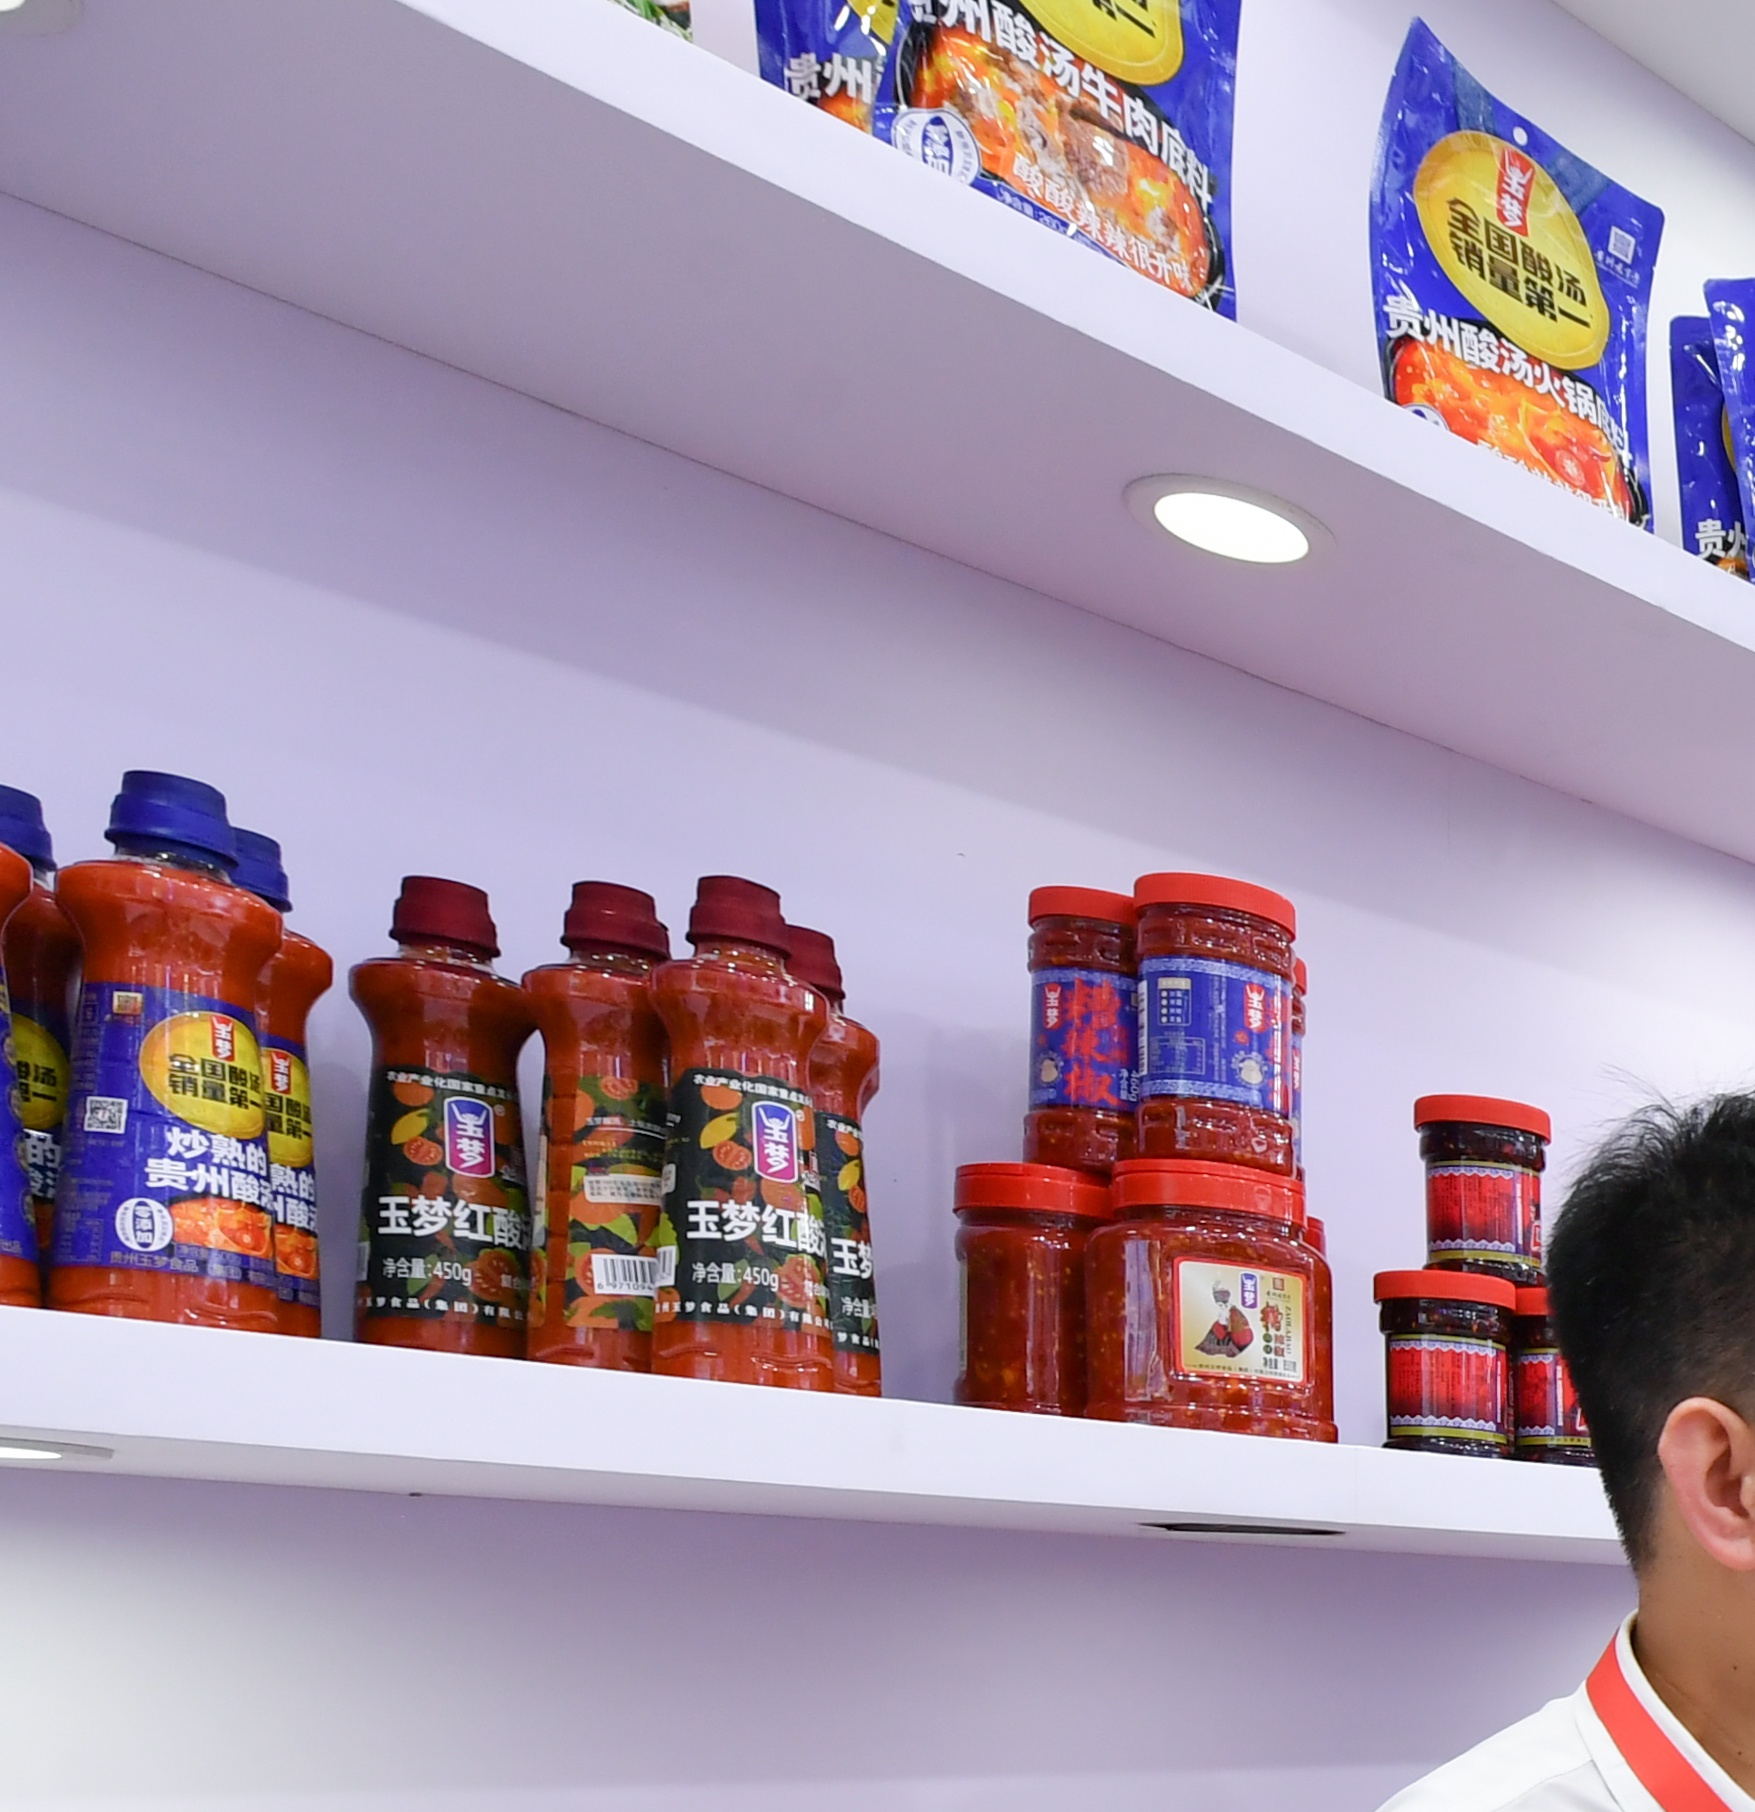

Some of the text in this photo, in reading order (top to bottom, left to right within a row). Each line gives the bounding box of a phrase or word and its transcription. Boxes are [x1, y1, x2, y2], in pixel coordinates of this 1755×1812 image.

[784, 52, 882, 99] 贵州
[1447, 197, 1587, 306] 全国酸汤
[1451, 241, 1592, 329] 销量第一
[1384, 287, 1633, 467] 贵州酸汤火锅底料
[211, 1016, 235, 1060] 玉梦
[167, 1127, 269, 1177] 炒熟的
[452, 1105, 487, 1169] 玉梦
[758, 1107, 791, 1174] 玉梦
